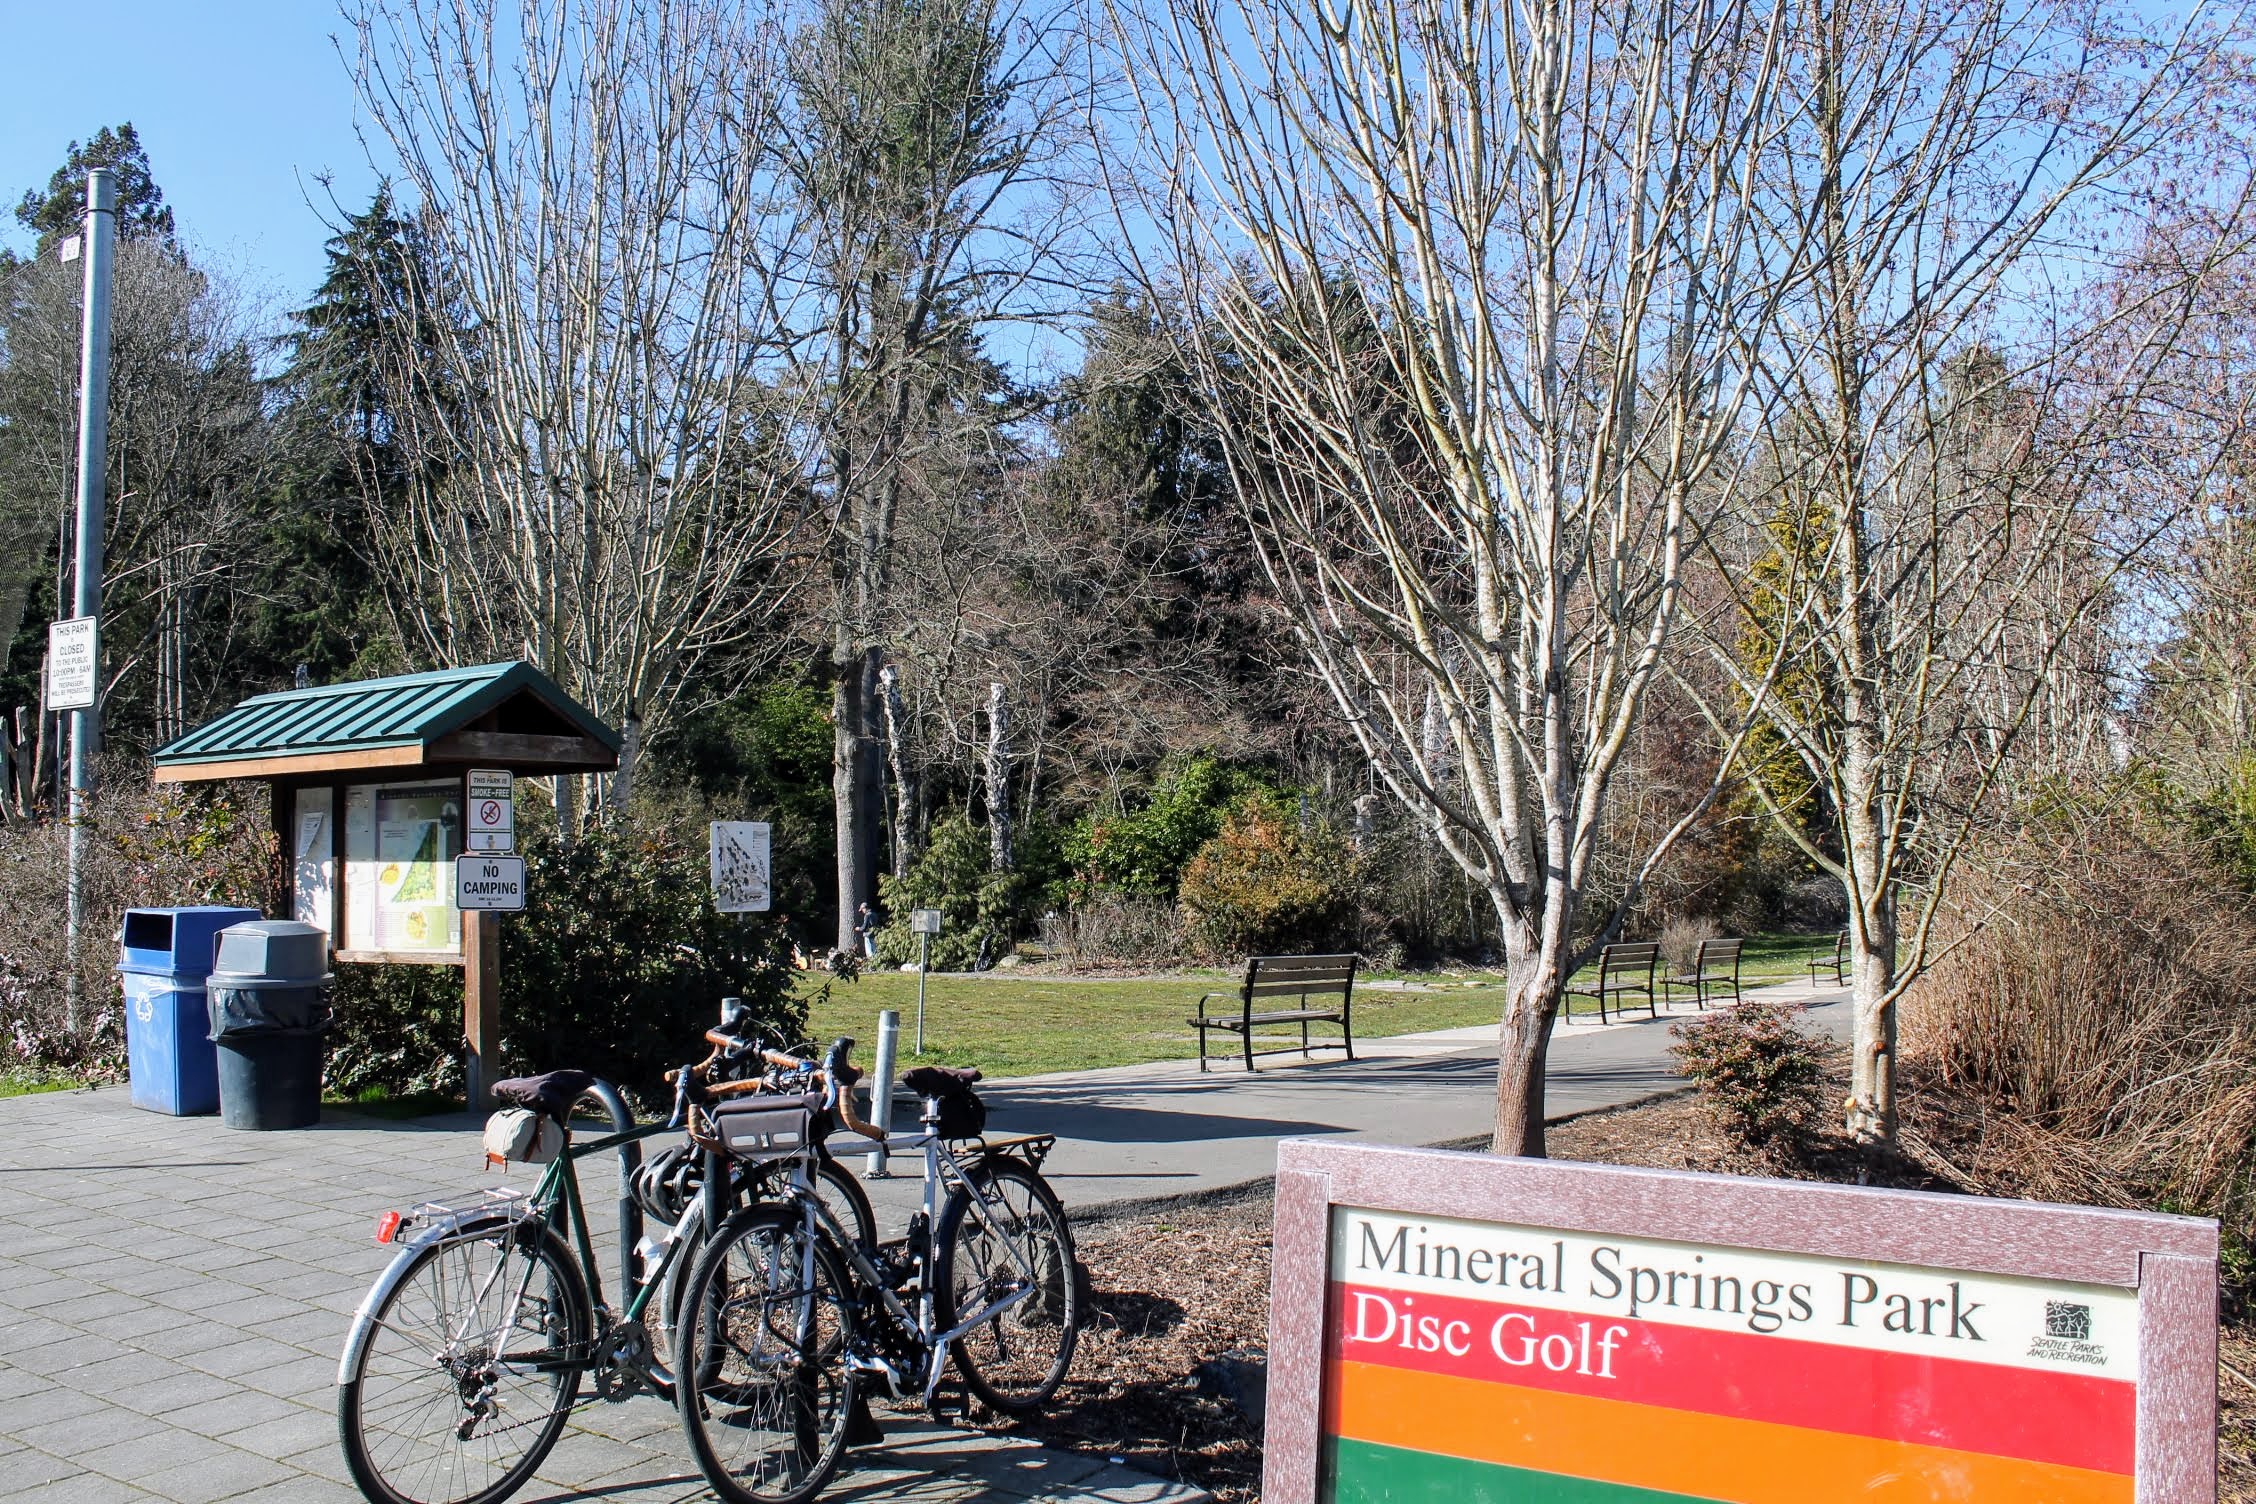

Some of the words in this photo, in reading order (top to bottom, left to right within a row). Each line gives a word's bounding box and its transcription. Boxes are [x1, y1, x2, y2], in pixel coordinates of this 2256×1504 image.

[56, 626, 70, 637] THIS
[72, 624, 89, 635] PARK
[60, 644, 85, 656] CLOSED
[72, 656, 88, 664] PUBLIC
[471, 788, 509, 798] SMOKE-FREE
[483, 865, 499, 878] NO
[464, 882, 517, 894] CAMPING
[1357, 1220, 1565, 1293] Mineral
[1589, 1246, 1814, 1334] Springs
[1836, 1271, 1988, 1342] Park
[1352, 1291, 1471, 1356] Disc
[1490, 1312, 1629, 1380] Golf
[2031, 1336, 2069, 1350] SEATTLE
[2070, 1340, 2104, 1355] PARKS
[2027, 1348, 2048, 1358] AND
[2048, 1350, 2108, 1366] RECREATION
